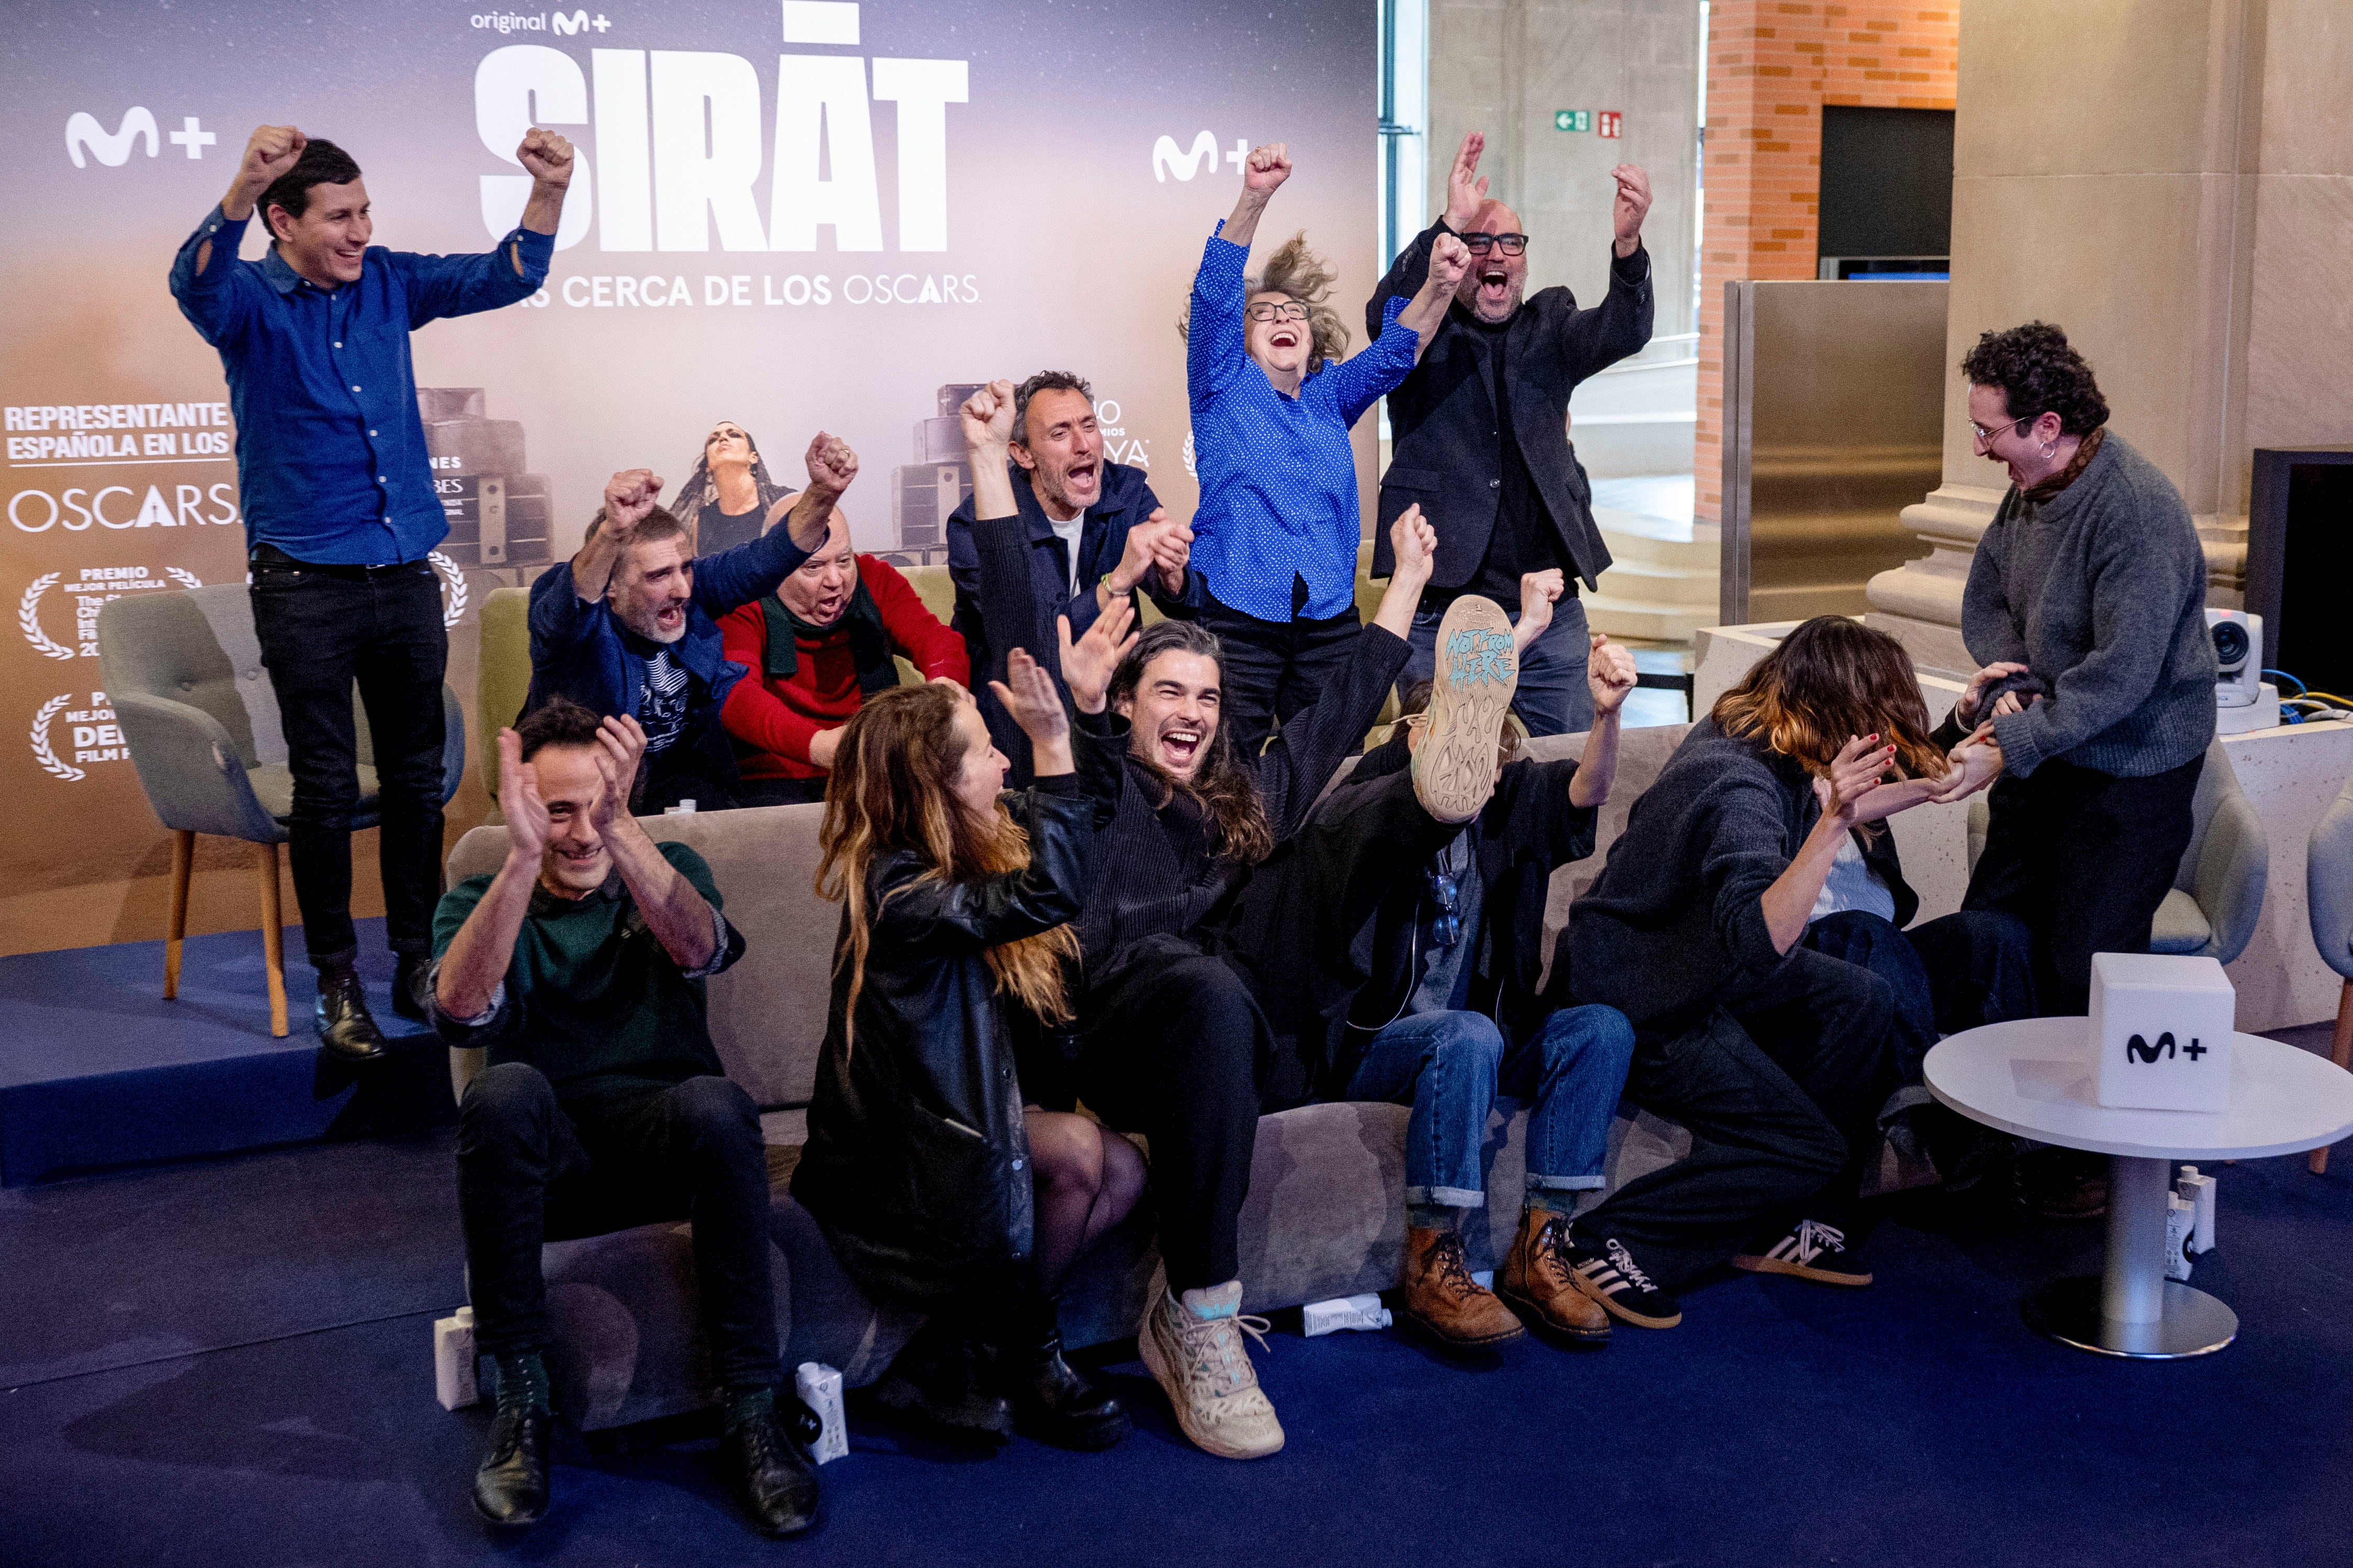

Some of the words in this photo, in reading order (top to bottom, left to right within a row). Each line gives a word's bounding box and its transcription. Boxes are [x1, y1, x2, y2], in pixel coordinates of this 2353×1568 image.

[470, 10, 546, 34] original
[562, 275, 694, 307] CERCA
[704, 275, 753, 306] DE
[764, 274, 833, 306] LOS
[4, 402, 229, 431] REPRESENTANTE
[7, 431, 139, 459] ESPAÑOLA
[143, 433, 177, 455] EN
[182, 432, 230, 455] LOS
[1099, 427, 1125, 437] MIOS
[1104, 439, 1150, 467] YA
[80, 566, 149, 581] PREMIO
[1448, 650, 1516, 693] HERE
[75, 748, 119, 763] FILM
